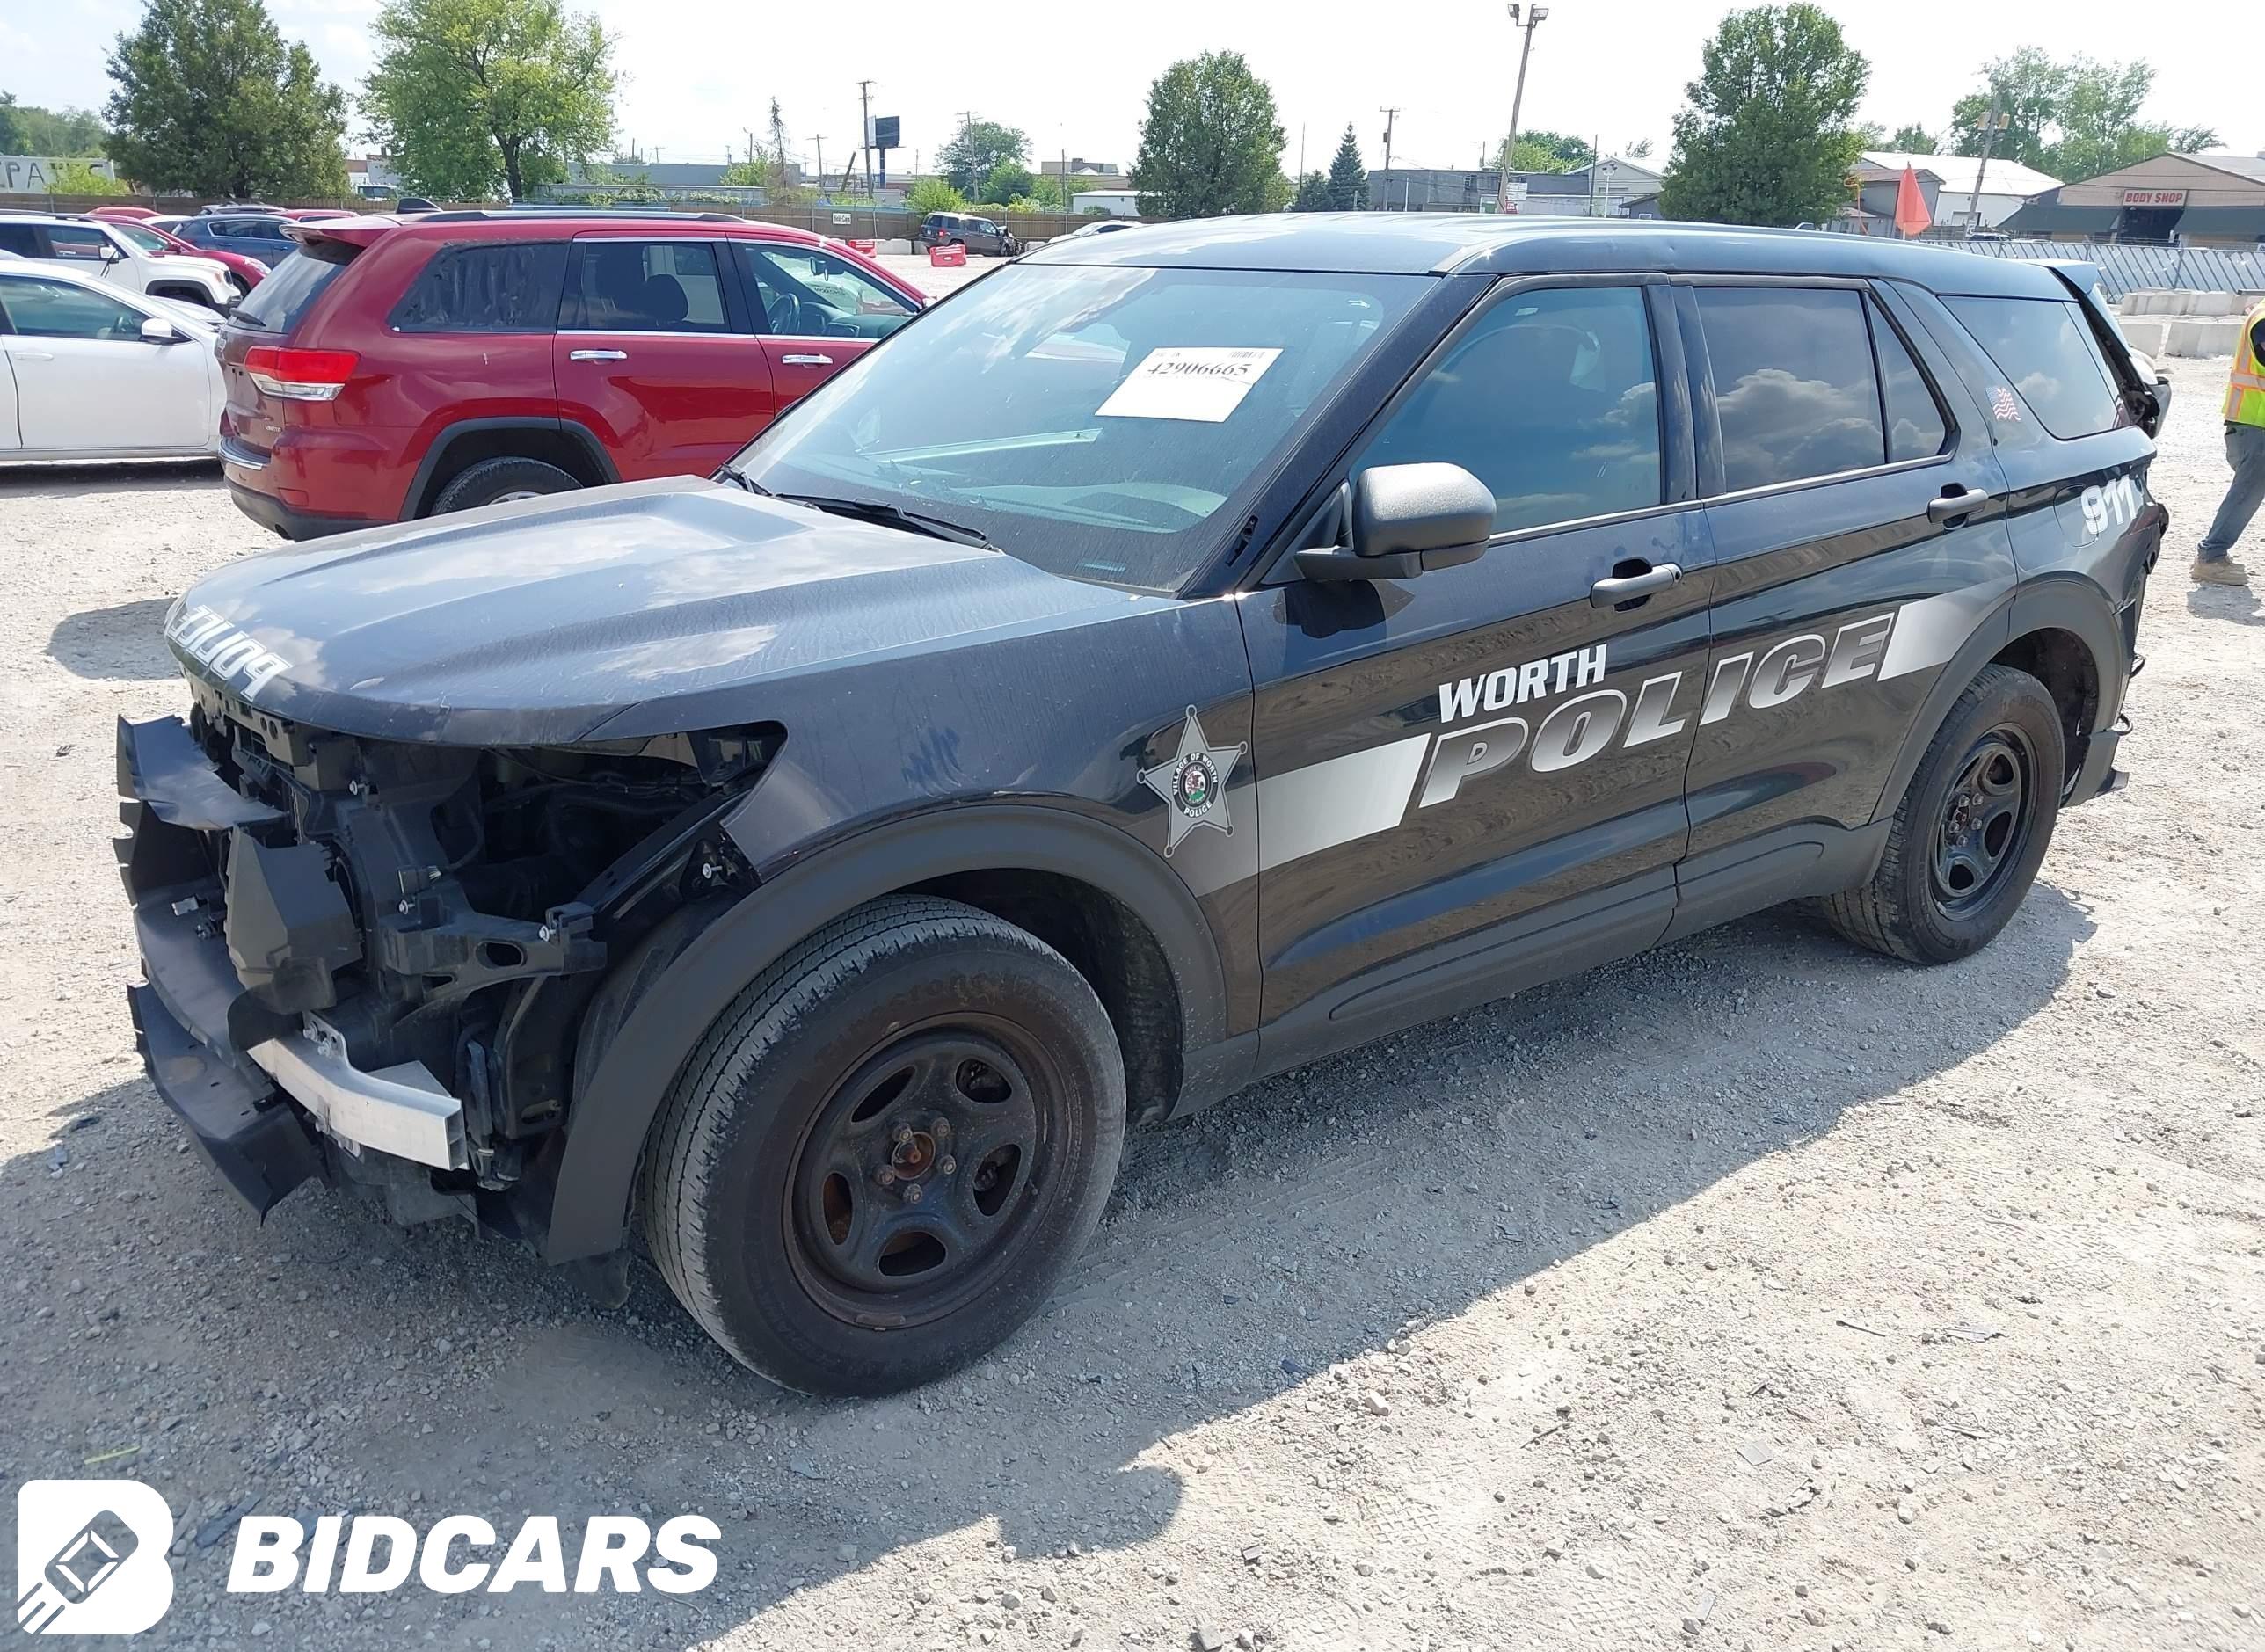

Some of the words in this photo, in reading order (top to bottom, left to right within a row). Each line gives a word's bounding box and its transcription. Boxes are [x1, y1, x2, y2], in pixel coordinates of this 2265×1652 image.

[2125, 193, 2153, 203] BODY
[2154, 193, 2183, 203] SHOP
[1147, 362, 1253, 376] 42906665
[2080, 473, 2138, 535] 911
[1438, 644, 1607, 724] WORTH
[1418, 611, 1896, 809] POLICE
[1172, 757, 1189, 796] VILLAGE
[1202, 755, 1219, 783] WORTH
[1183, 800, 1213, 818] POLICE
